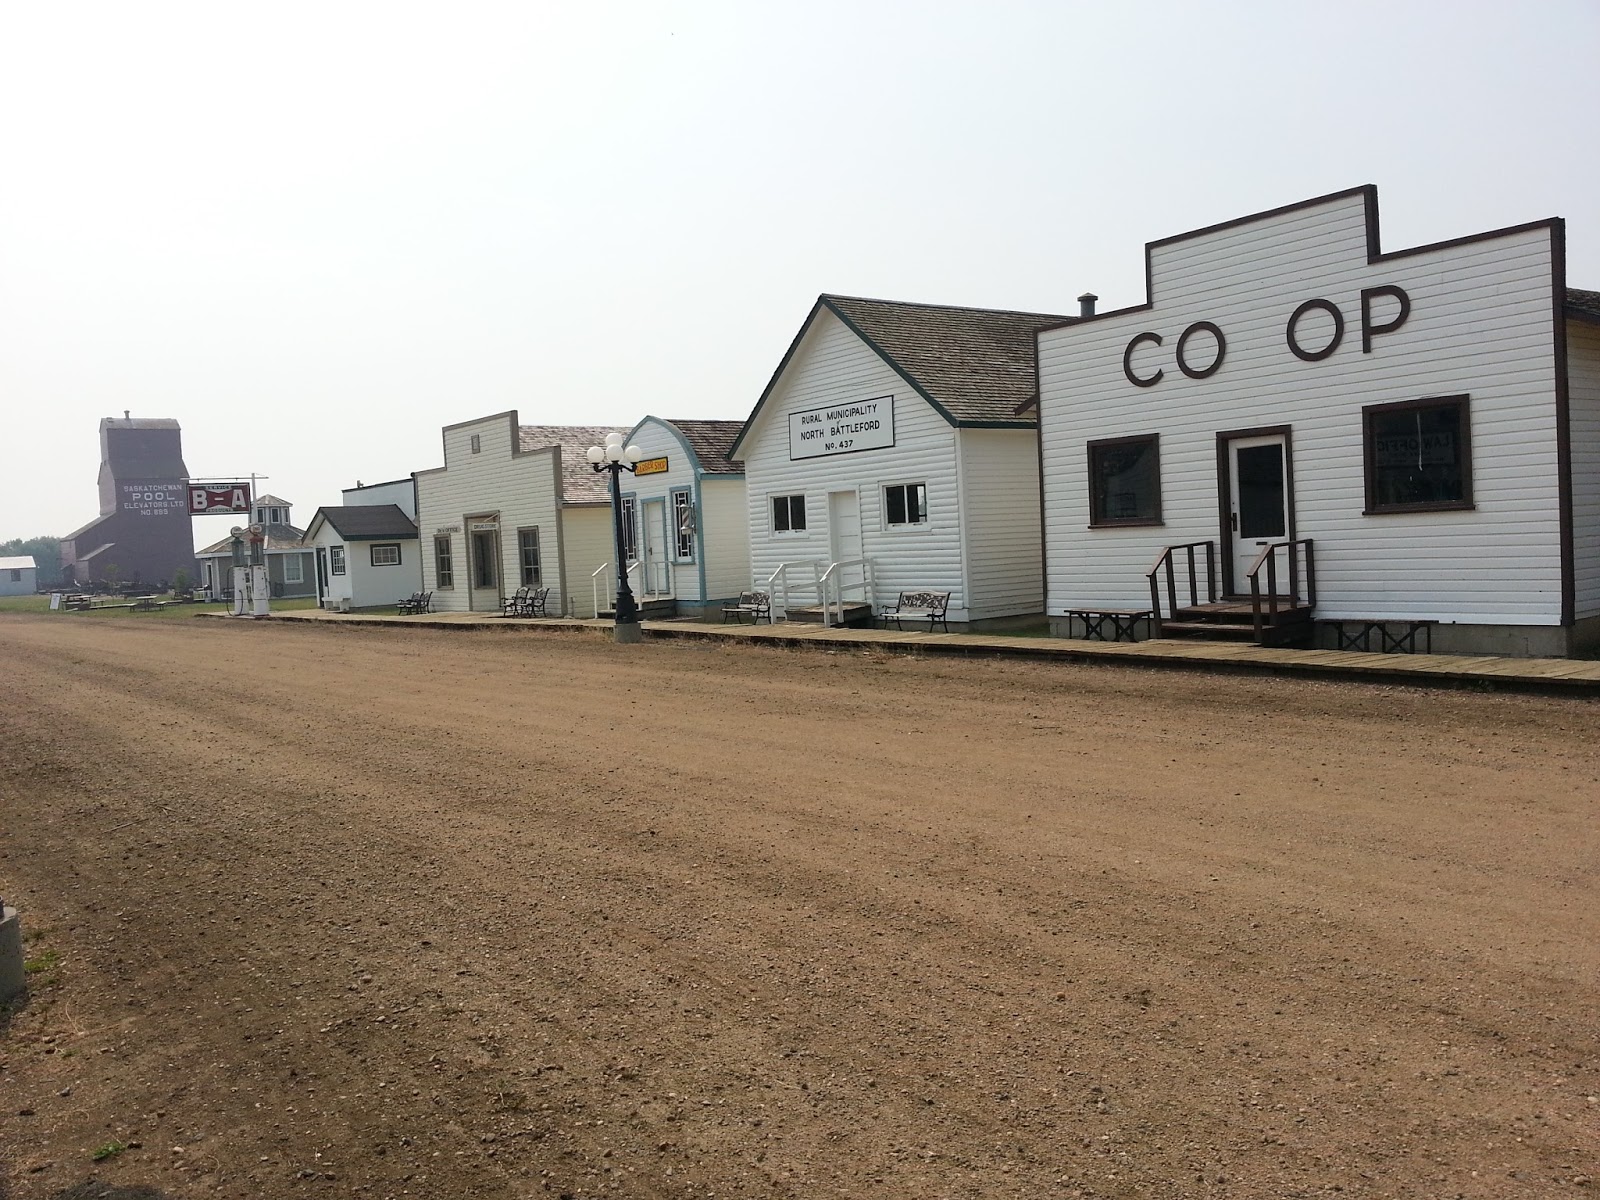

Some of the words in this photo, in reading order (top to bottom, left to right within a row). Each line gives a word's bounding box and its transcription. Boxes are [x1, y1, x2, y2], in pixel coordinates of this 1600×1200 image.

[802, 414, 822, 425] RURAL
[827, 404, 877, 421] MUNICIPALITY
[801, 429, 824, 441] NORTH
[830, 420, 880, 436] BATTLEFORD
[839, 439, 854, 449] 437
[655, 460, 666, 470] SHOP
[132, 492, 175, 501] POOL
